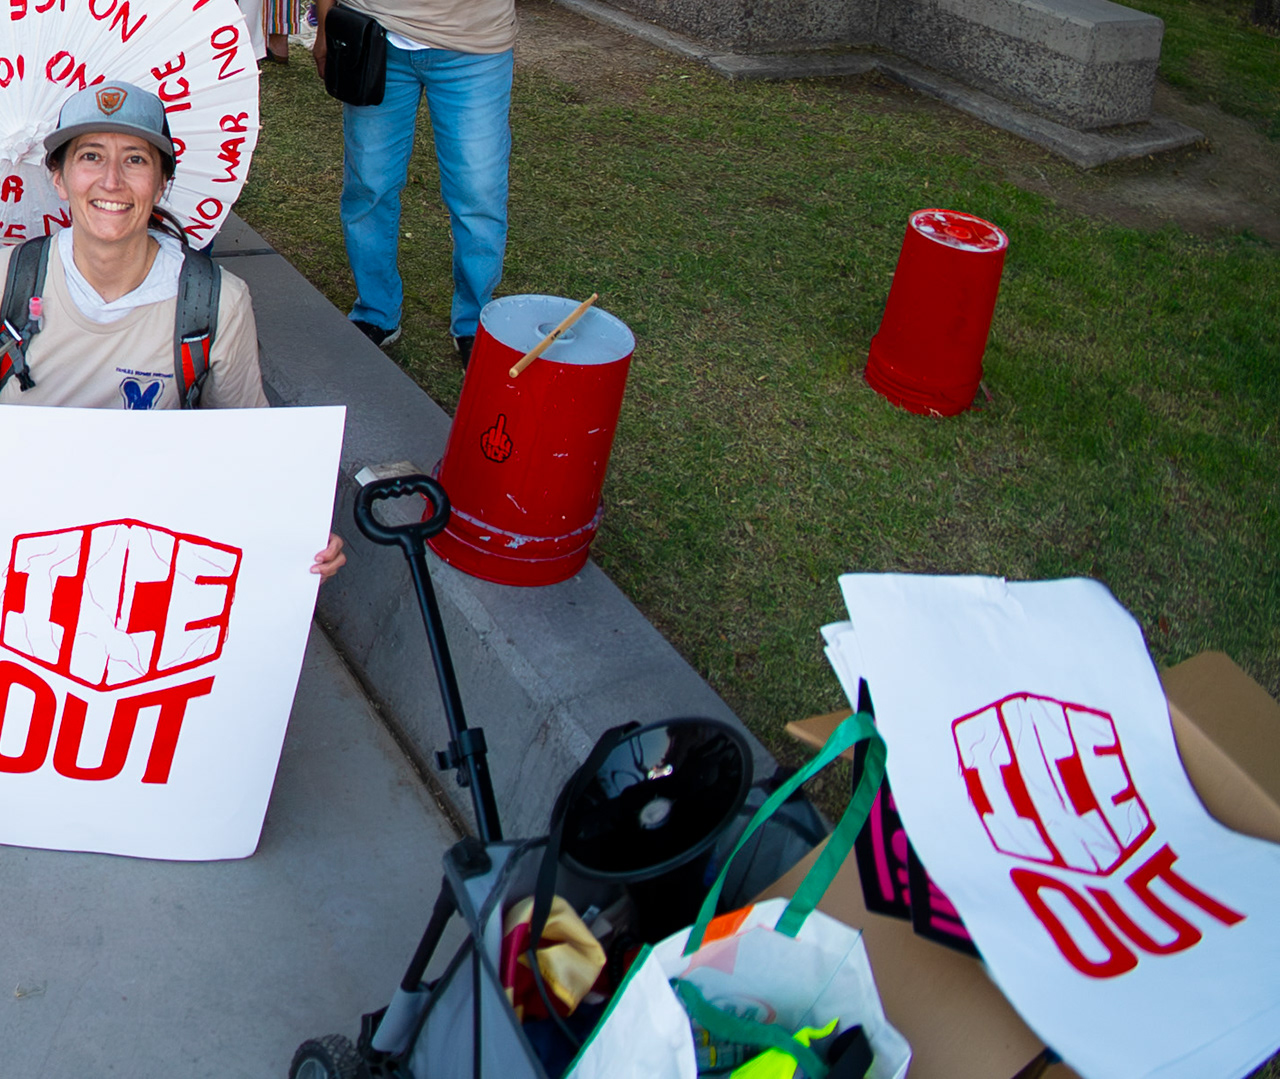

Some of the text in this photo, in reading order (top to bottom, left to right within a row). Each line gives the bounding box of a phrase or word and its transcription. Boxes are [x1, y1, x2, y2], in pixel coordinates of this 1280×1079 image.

[150, 51, 192, 114] ICE
[210, 24, 245, 81] NO
[211, 111, 249, 184] WAR
[183, 197, 224, 241] NO
[952, 691, 1157, 878] ICE
[1009, 844, 1247, 979] OUT
